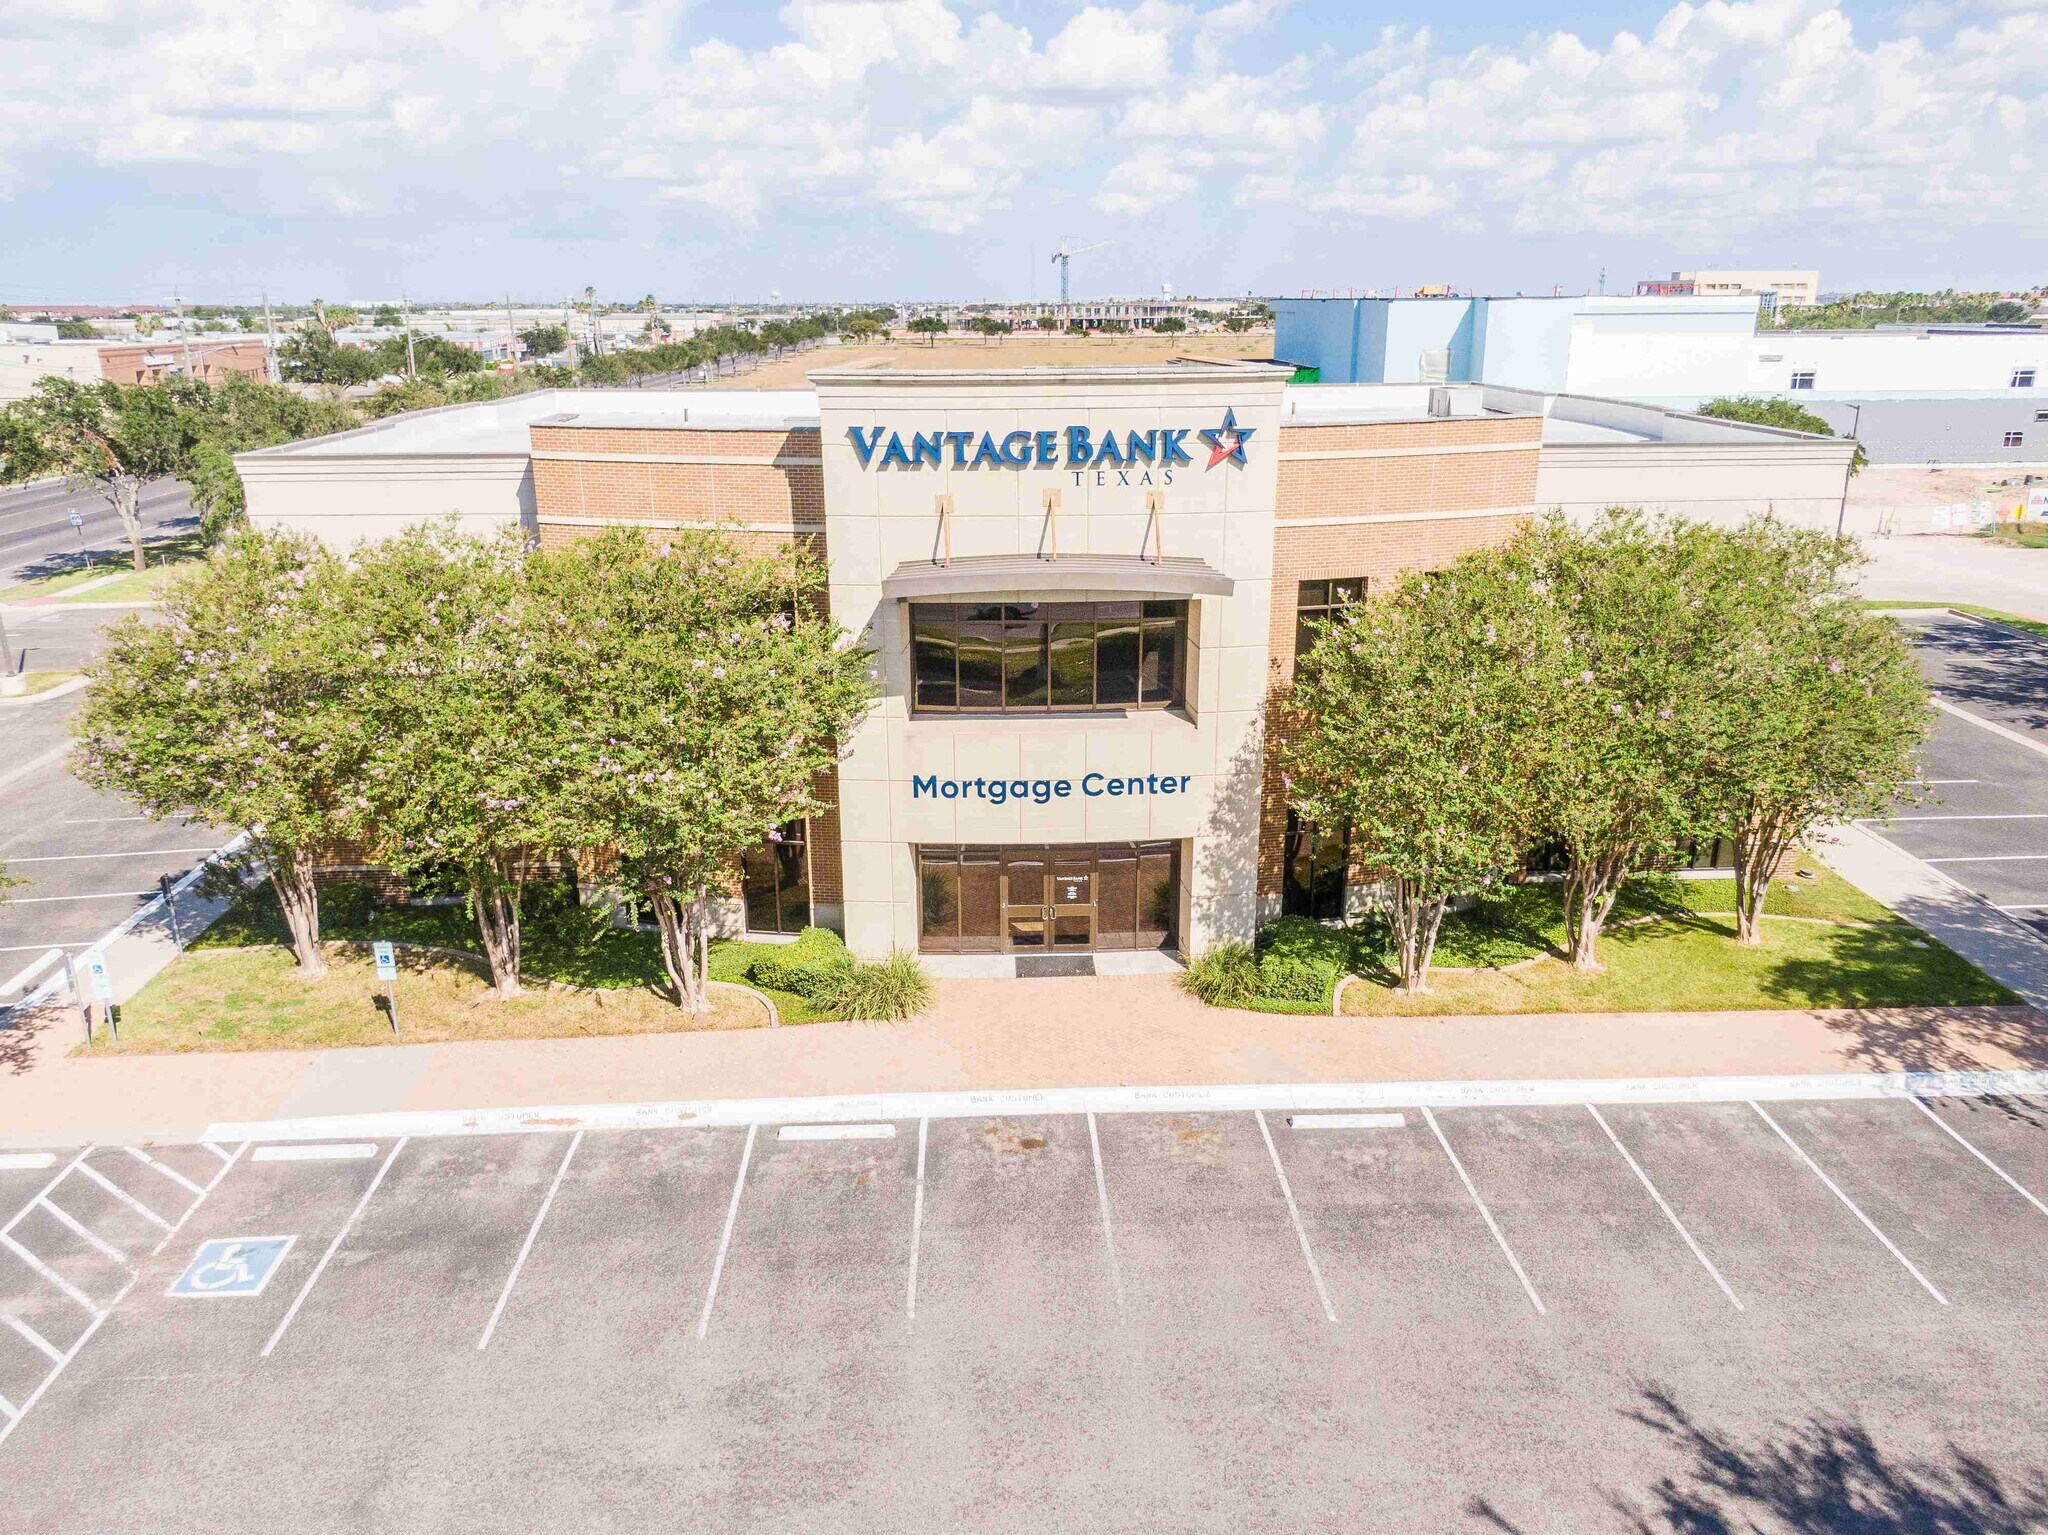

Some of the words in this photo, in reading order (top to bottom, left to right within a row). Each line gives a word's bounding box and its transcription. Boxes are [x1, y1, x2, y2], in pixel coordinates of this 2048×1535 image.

[1071, 469, 1174, 487] TEXAS
[912, 774, 1072, 805] Mortgage
[1081, 772, 1191, 797] Center
[970, 1095, 994, 1104] BANK
